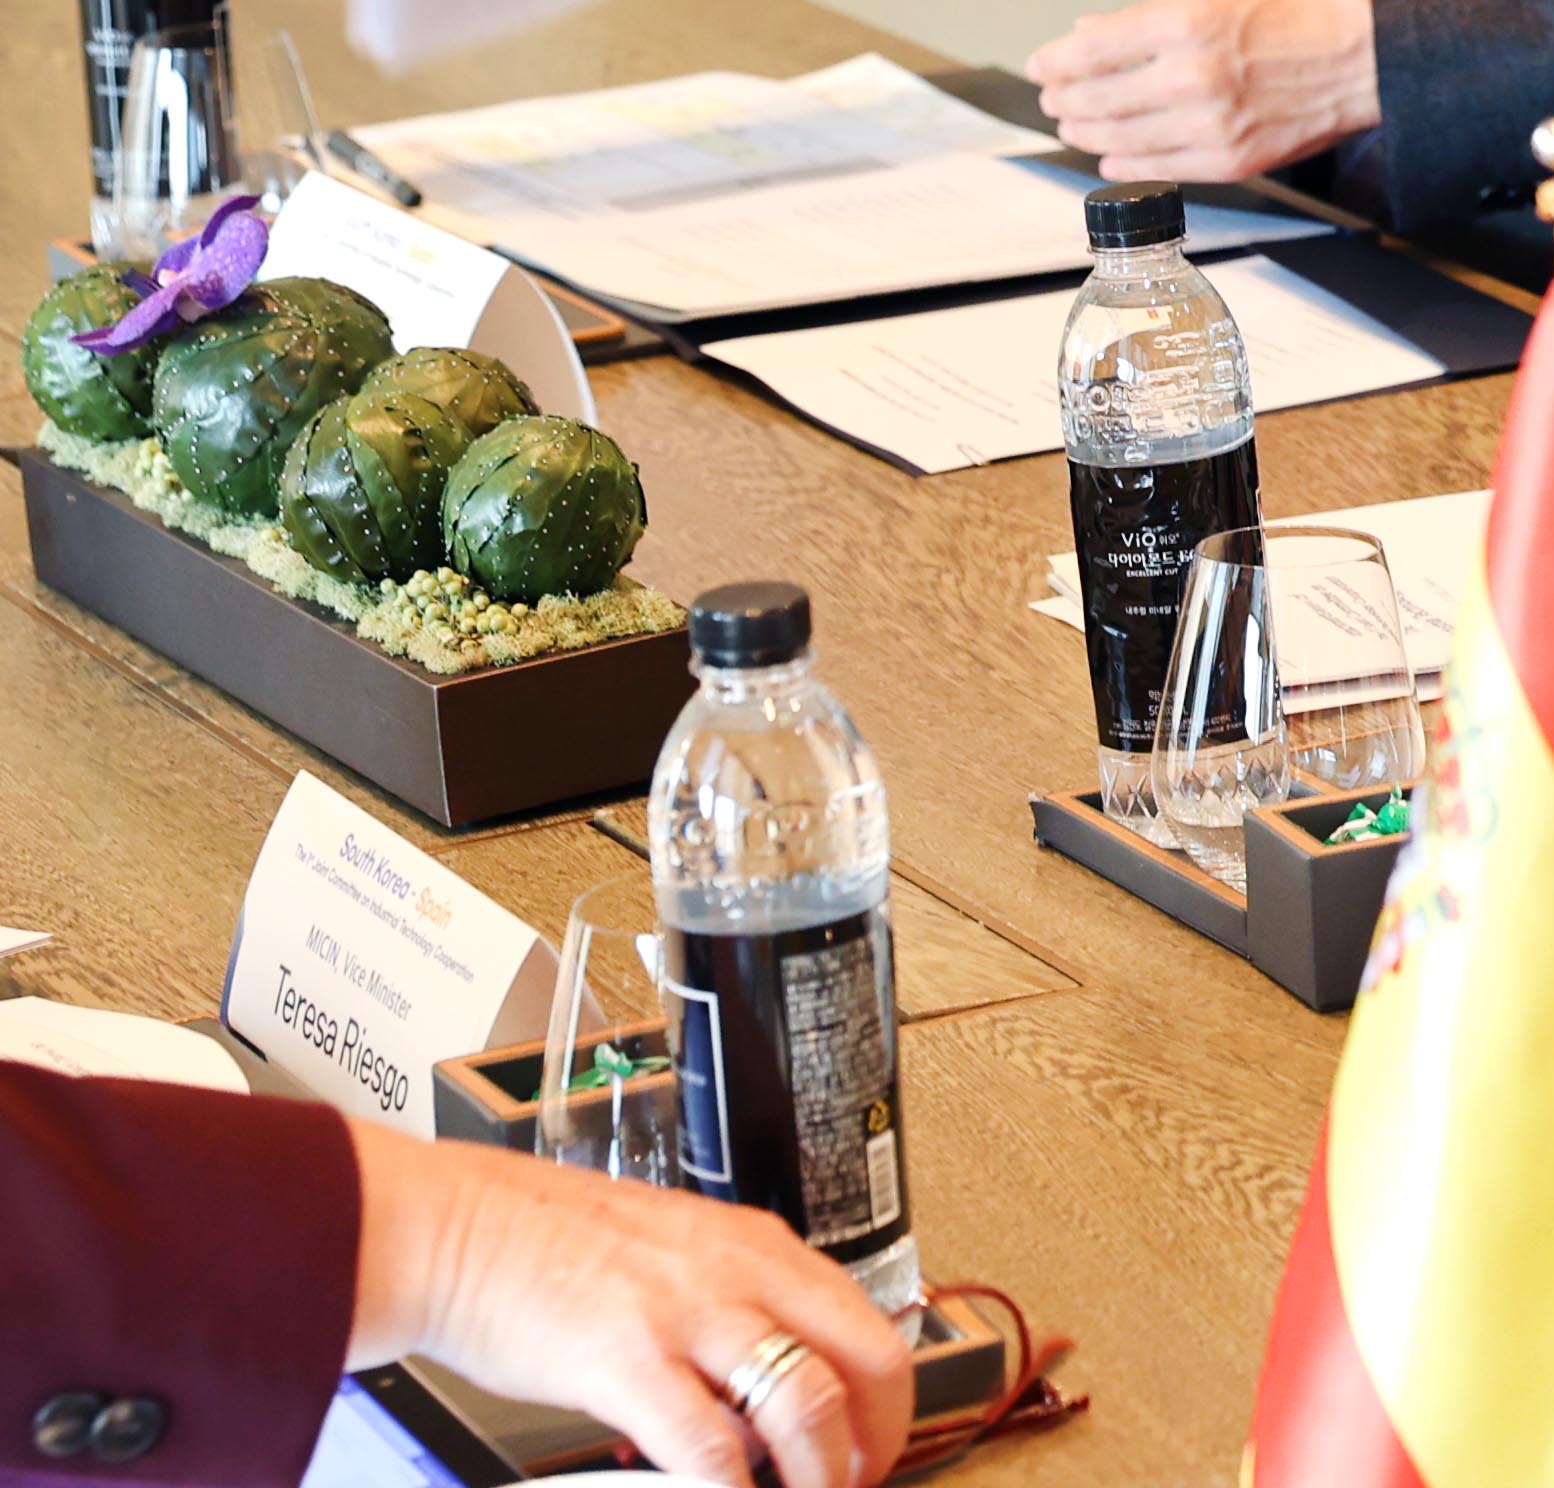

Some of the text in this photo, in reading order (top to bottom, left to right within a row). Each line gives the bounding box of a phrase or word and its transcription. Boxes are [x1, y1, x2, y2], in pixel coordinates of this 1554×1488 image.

[339, 833, 376, 876] South
[373, 856, 411, 900] Korea
[415, 886, 452, 930] Spain
[305, 924, 412, 1021] MICIN, Vice Minister
[274, 964, 409, 1112] Teresa Riesgo
